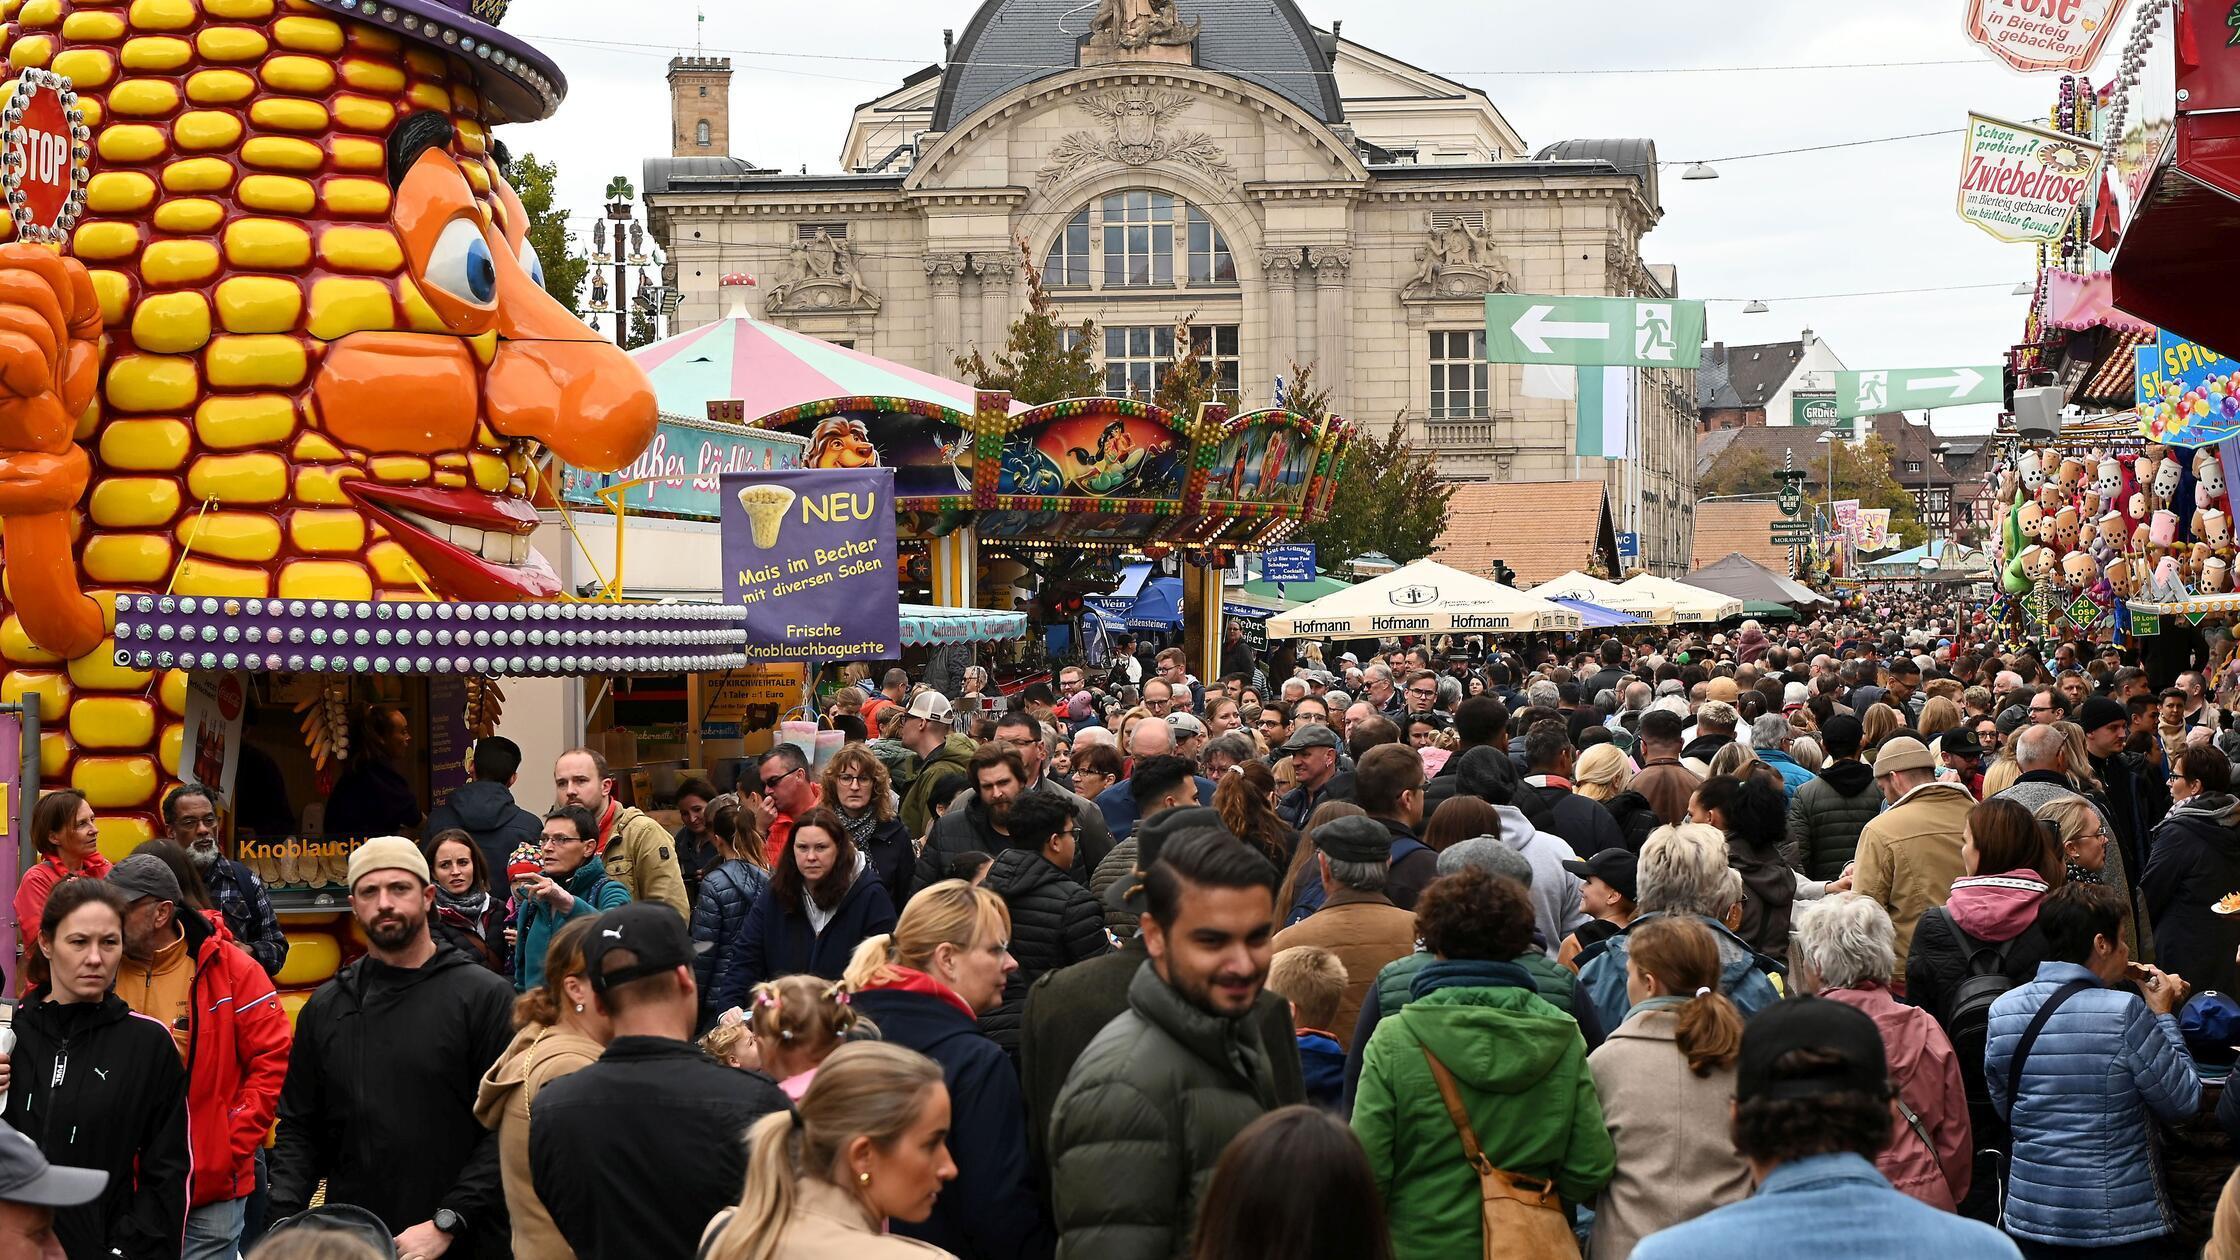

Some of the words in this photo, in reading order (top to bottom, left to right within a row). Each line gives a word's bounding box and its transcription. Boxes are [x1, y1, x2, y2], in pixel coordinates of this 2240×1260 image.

[1987, 11, 2003, 24] in
[2007, 15, 2070, 41] Bierteig
[1998, 29, 2084, 56] gebacken!
[1976, 124, 2015, 141] Schon
[14, 125, 67, 186] STOP
[1976, 139, 2040, 157] probiert?
[1962, 156, 2086, 205] Zwiebelrose
[1966, 193, 1978, 204] im
[1979, 194, 2013, 212] Bierteig
[2012, 201, 2067, 218] gebacken
[1966, 207, 1978, 216] ein
[1979, 208, 2022, 225] köstlicher
[2021, 217, 2060, 236] Genuß
[802, 492, 875, 524] NEU
[1616, 535, 1630, 544] WC
[1266, 546, 1279, 555] Gut
[738, 565, 781, 587] Mais
[787, 558, 809, 574] im
[814, 538, 878, 566] Becher
[742, 588, 766, 604] mit
[772, 570, 833, 597] diversen
[838, 558, 882, 578] Soßen
[1100, 599, 1126, 608] Wein
[2071, 607, 2096, 616] Lose
[2077, 599, 2089, 608] 20
[1293, 619, 1351, 633] Hofmann
[1372, 616, 1429, 630] Hofmann
[1451, 615, 1509, 628] Hofmann
[2077, 615, 2090, 624] 5€
[786, 622, 842, 638] Frische
[744, 641, 885, 659] Knoblauchbaguette
[726, 679, 796, 687] KIRCHWEIHTALER
